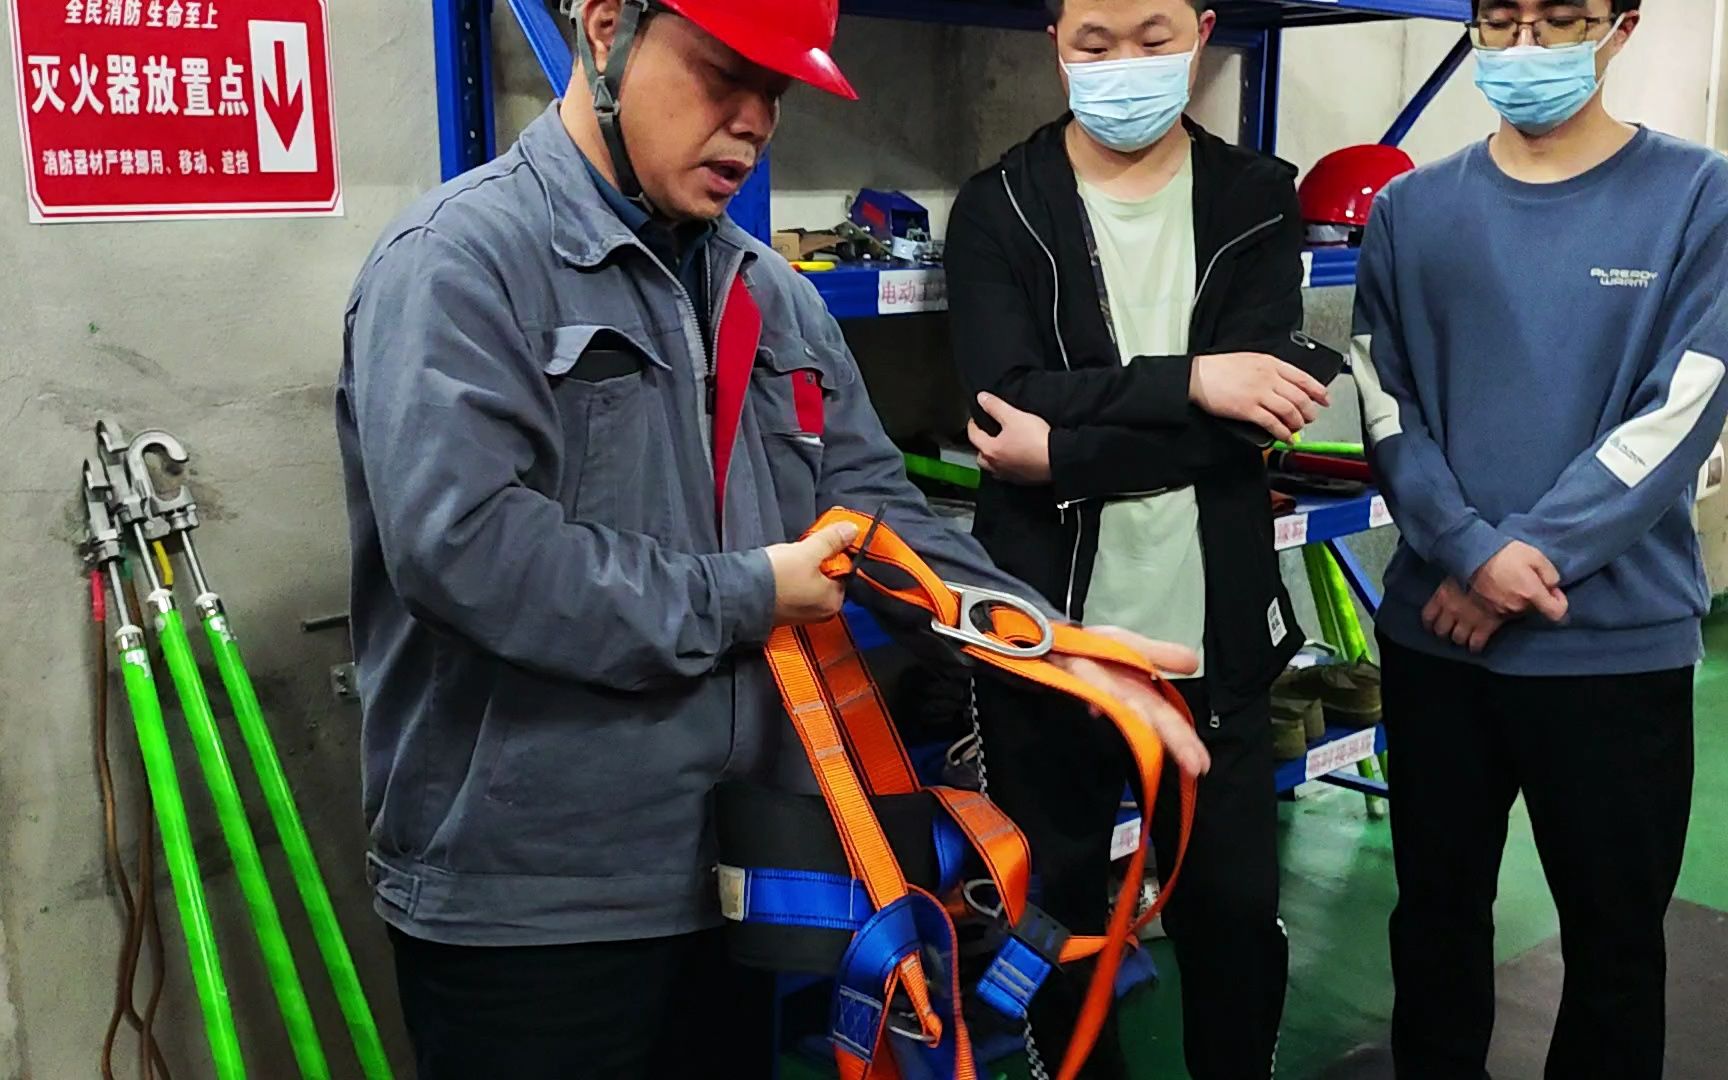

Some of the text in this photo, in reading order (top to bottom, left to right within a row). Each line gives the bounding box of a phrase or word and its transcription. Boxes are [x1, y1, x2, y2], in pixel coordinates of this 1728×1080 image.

[64, 0, 219, 29] 全民消防 生命至上
[27, 53, 249, 116] 灭火器放置点
